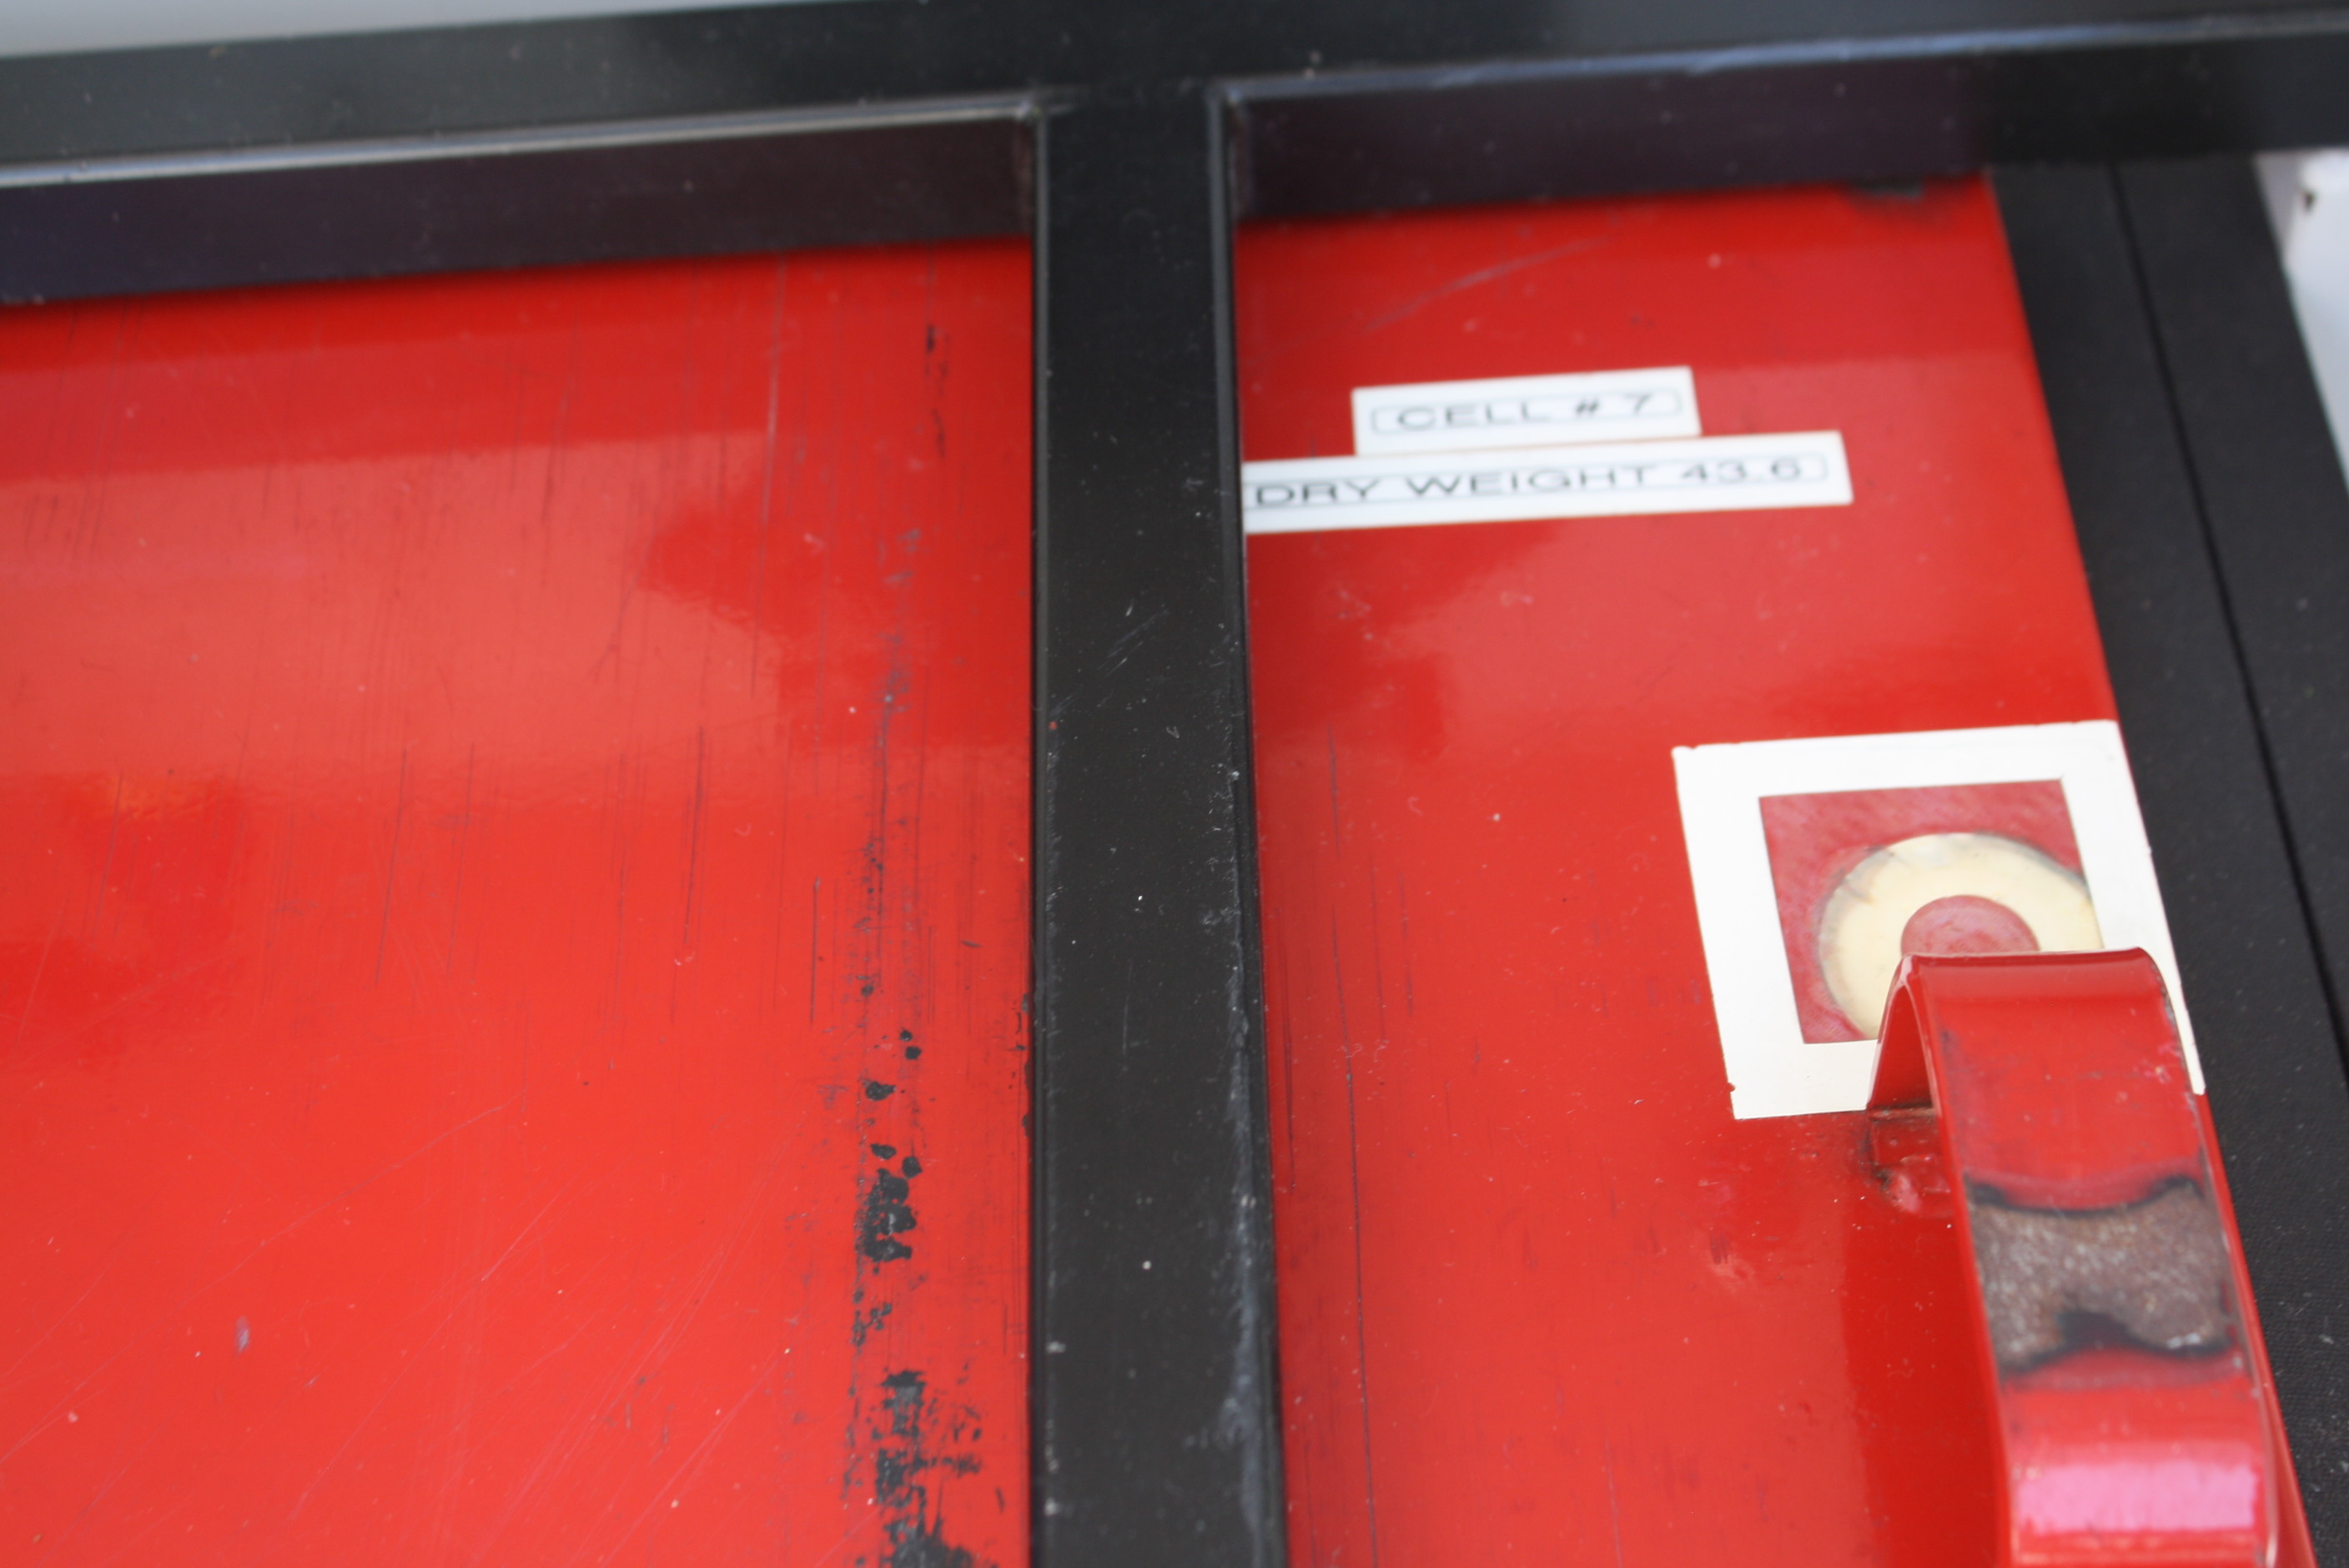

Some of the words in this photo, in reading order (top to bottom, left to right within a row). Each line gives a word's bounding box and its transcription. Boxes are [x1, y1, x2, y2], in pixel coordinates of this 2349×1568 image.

[1396, 401, 1549, 430] CELL
[1255, 477, 1380, 505] DRY
[1406, 465, 1655, 495] WEIGHT
[1680, 458, 1803, 482] 43.6
